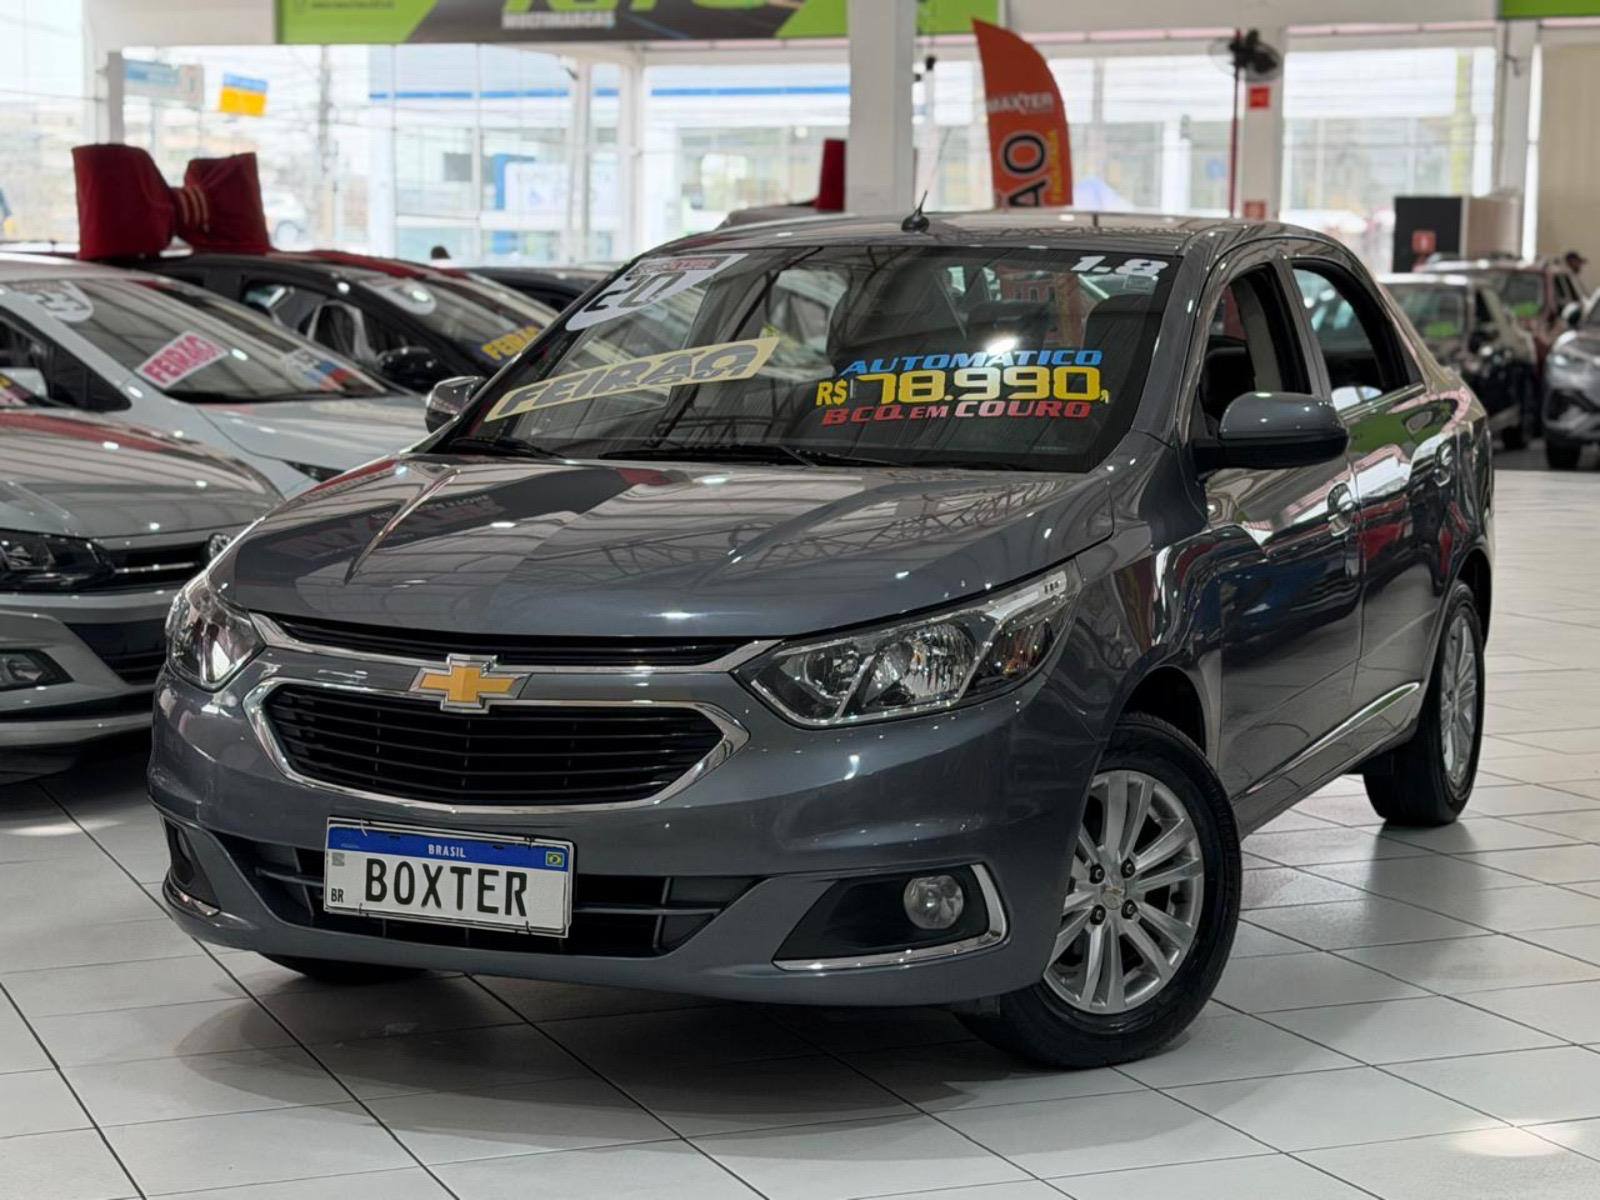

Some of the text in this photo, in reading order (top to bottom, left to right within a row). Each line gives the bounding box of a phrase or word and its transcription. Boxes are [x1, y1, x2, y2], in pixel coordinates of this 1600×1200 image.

[1070, 255, 1169, 277] 1.8
[816, 379, 848, 406] R$
[909, 405, 949, 420] EM
[954, 400, 1092, 419] COURO
[427, 843, 467, 859] BRASIL
[330, 887, 344, 904] BR
[365, 857, 528, 917] BOXTER
